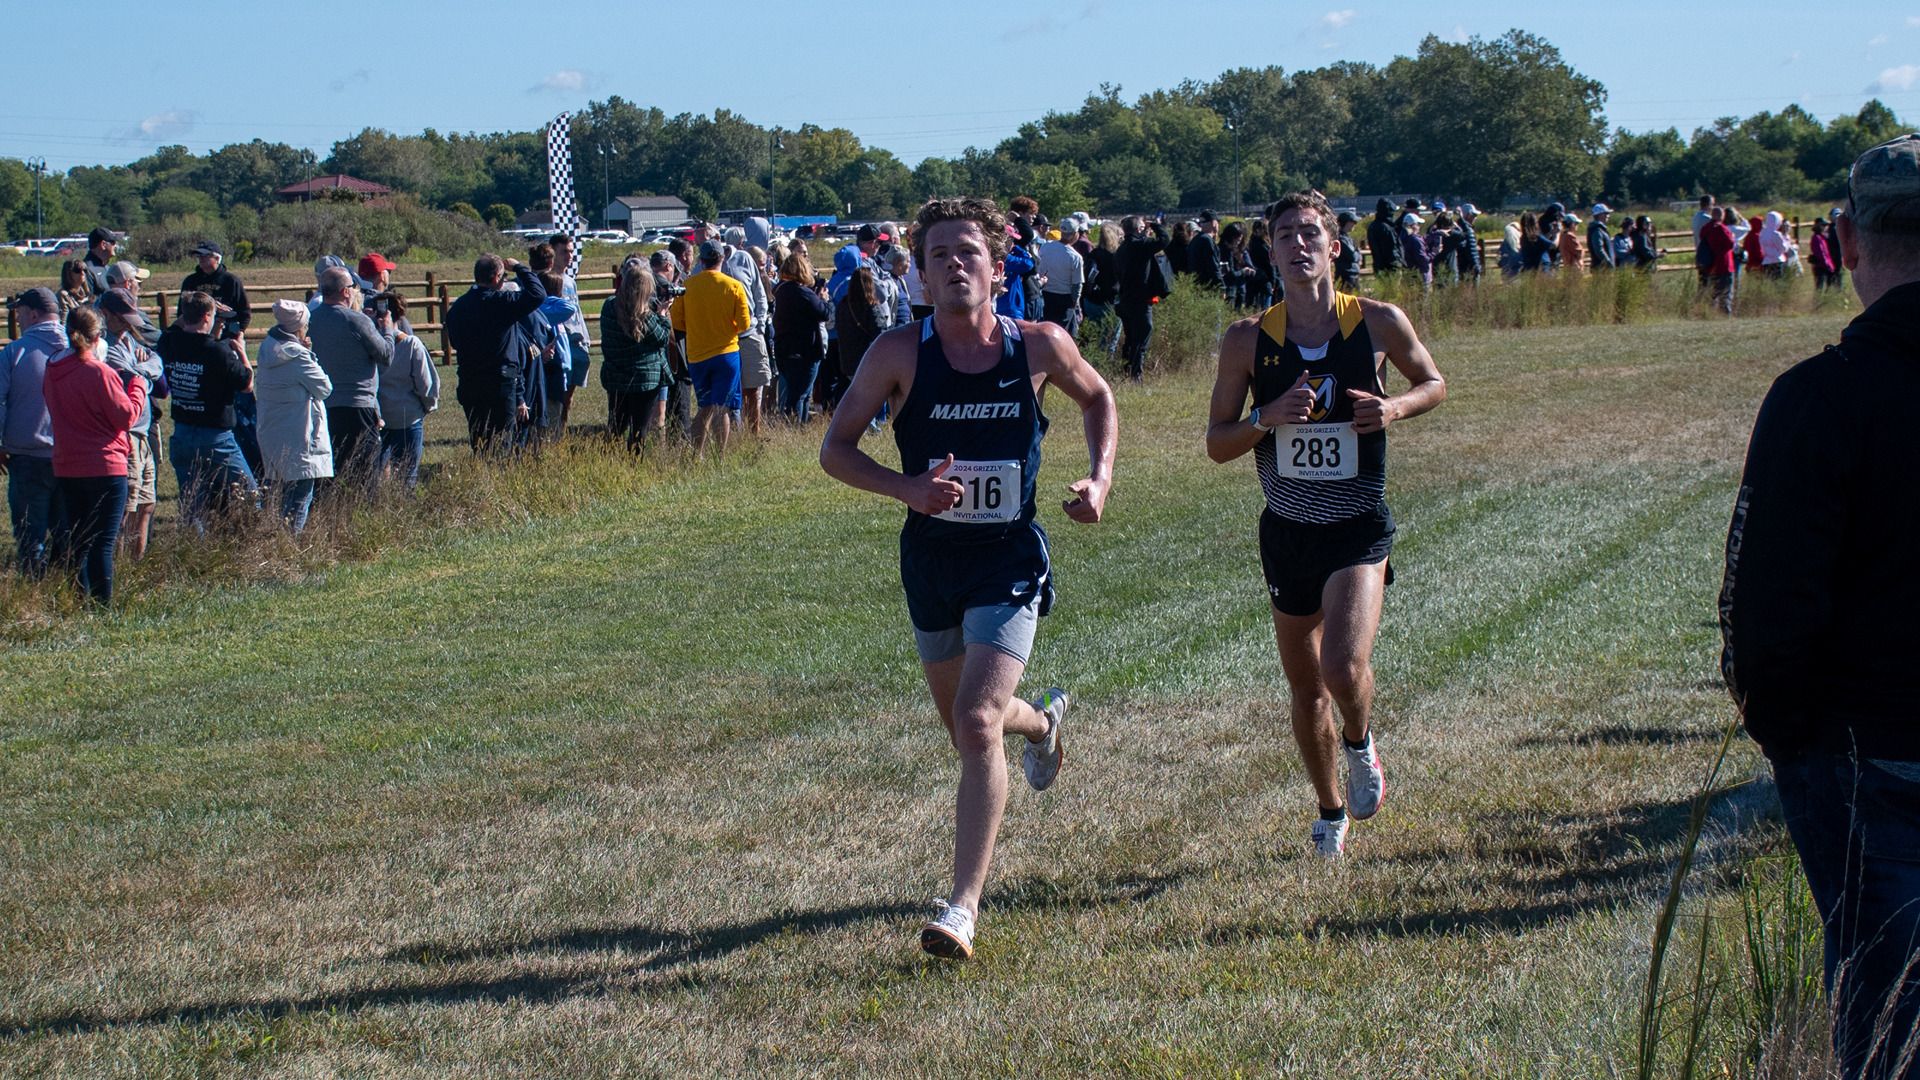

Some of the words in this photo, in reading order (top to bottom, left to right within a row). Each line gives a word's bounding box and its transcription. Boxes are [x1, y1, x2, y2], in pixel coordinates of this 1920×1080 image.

[929, 402, 1020, 420] MARIETTA
[1313, 426, 1341, 434] GRIZZLY
[1291, 437, 1341, 468] 283
[953, 464, 972, 472] 2024
[973, 464, 1003, 472] GRIZZLY
[953, 511, 1003, 519] INVITATIONAL
[1718, 484, 1754, 626] ARMOUR
